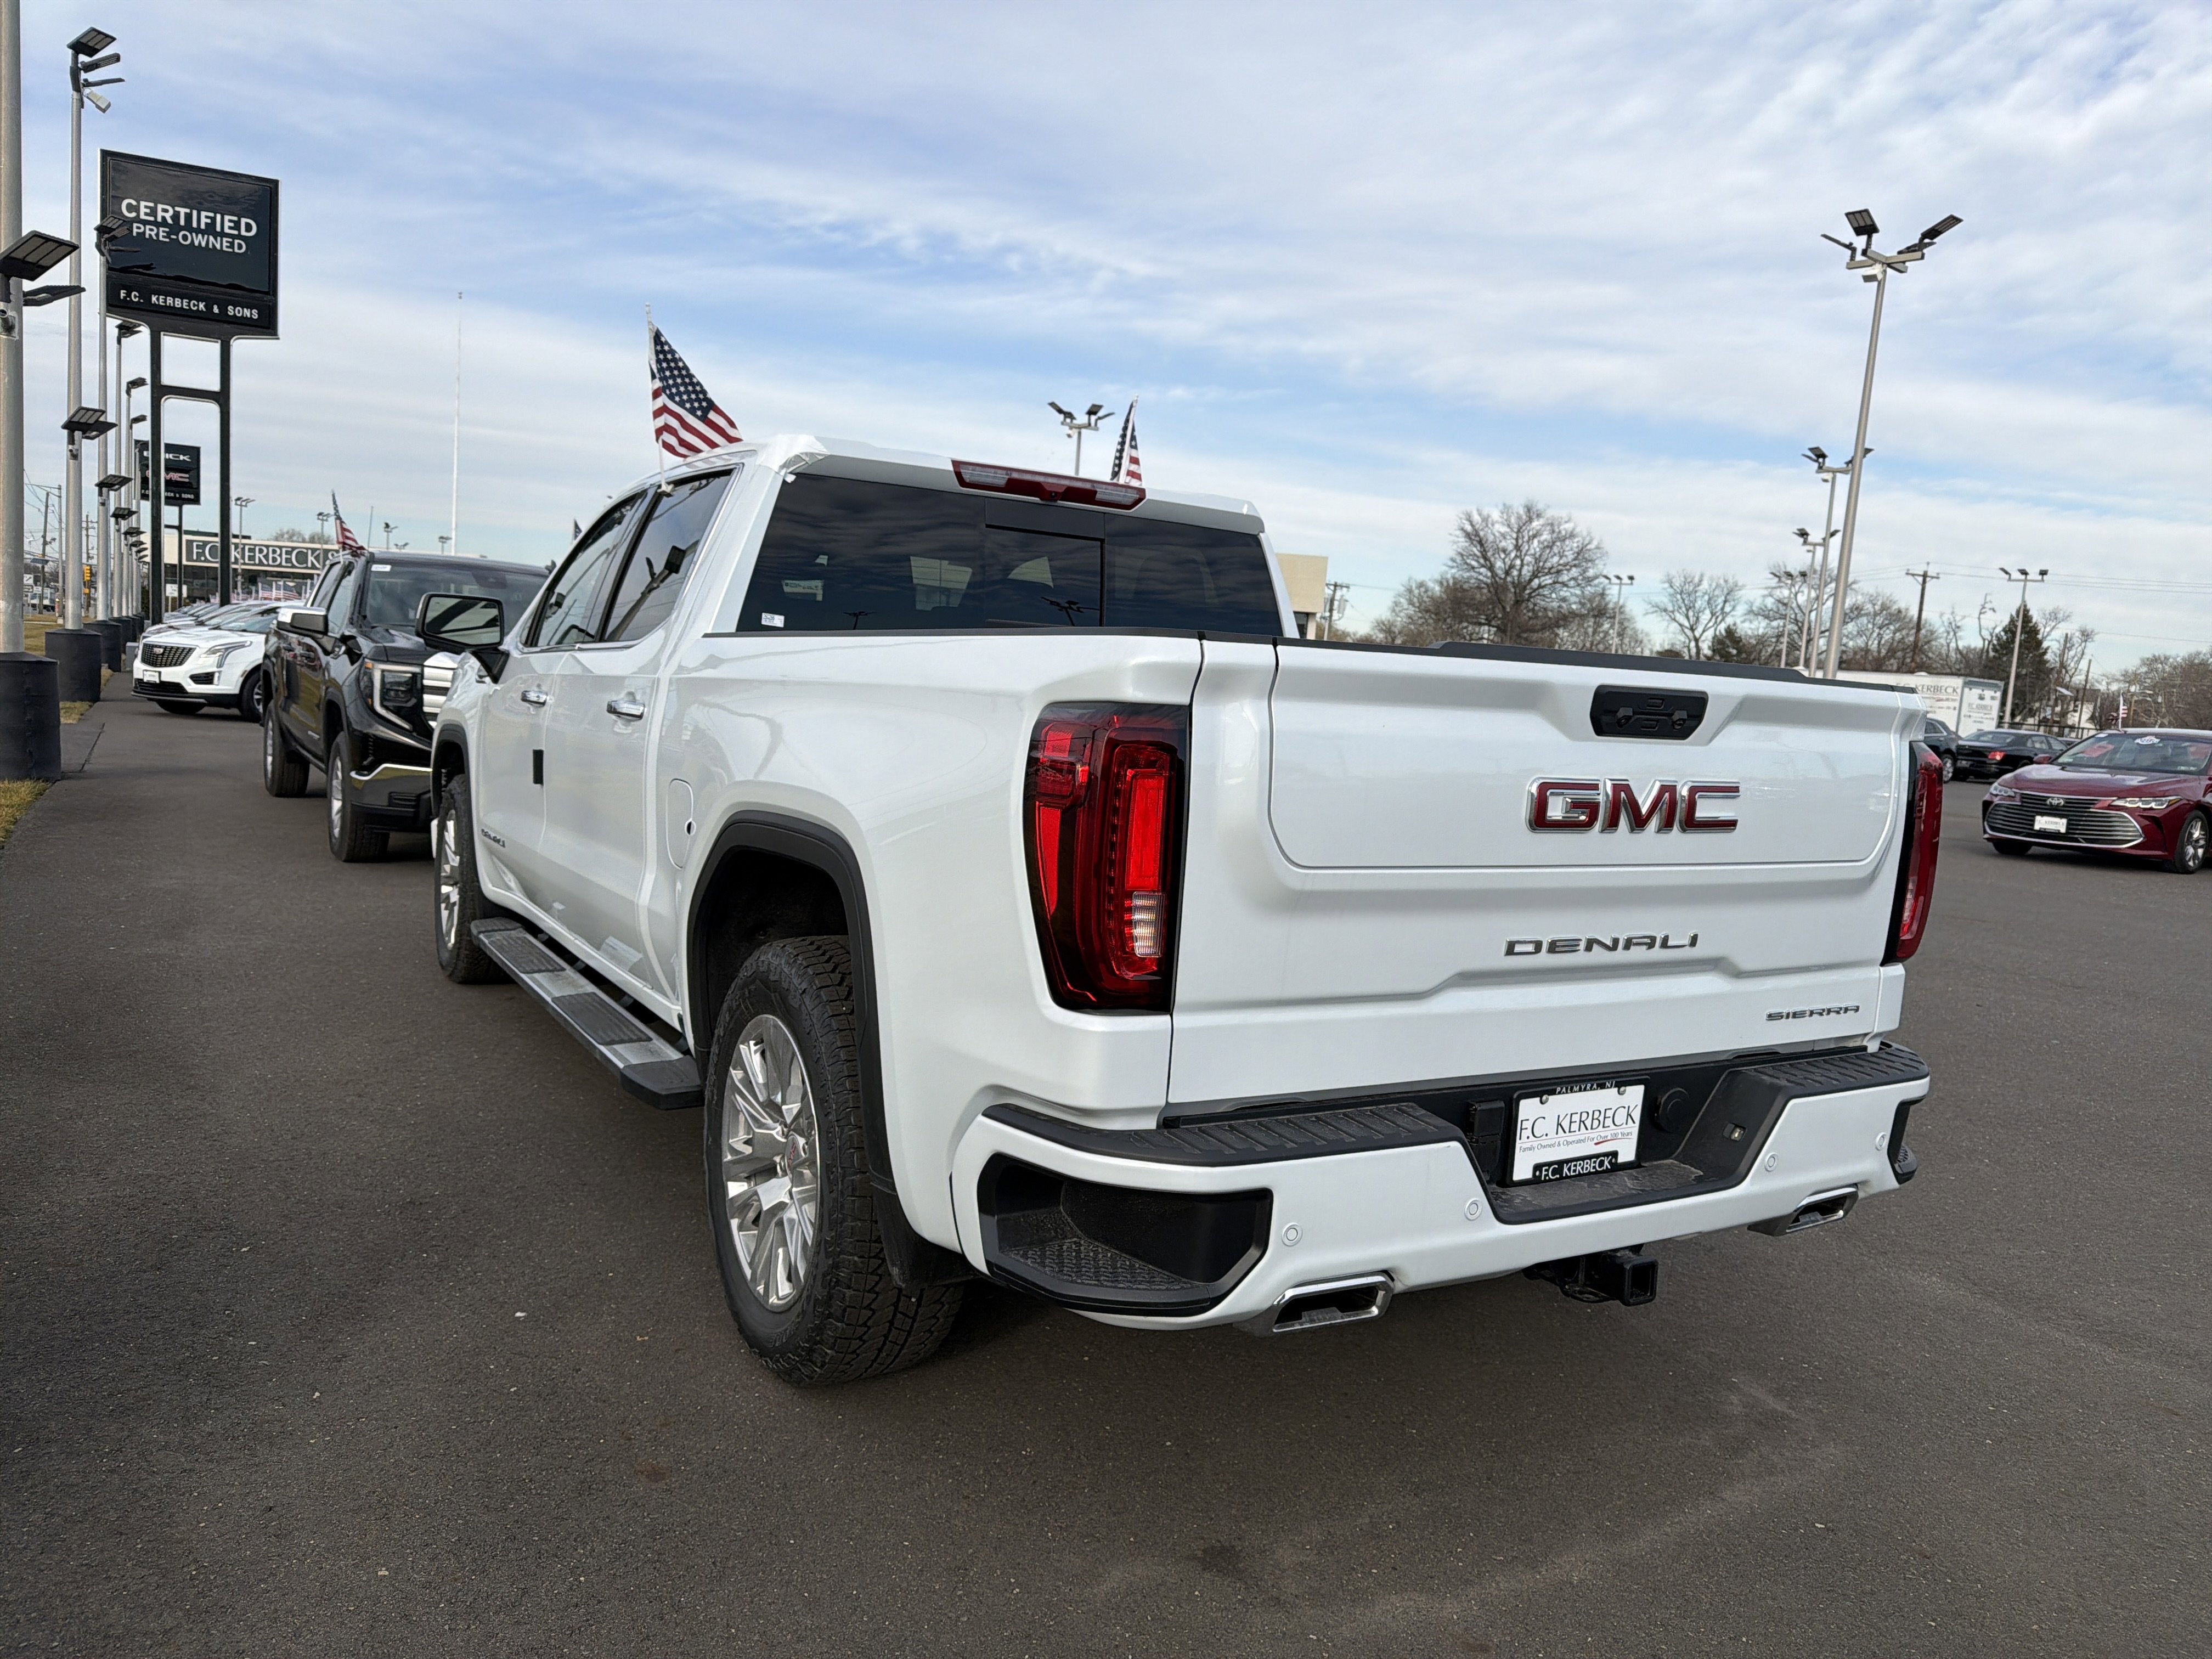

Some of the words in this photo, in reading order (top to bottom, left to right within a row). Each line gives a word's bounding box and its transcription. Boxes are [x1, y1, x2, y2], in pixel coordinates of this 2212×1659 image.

[121, 198, 257, 236] CERTIFIED
[132, 223, 246, 253] PRE-OWNED
[120, 290, 144, 302] F.C.
[151, 294, 206, 312] KERBECK
[213, 304, 219, 314] &
[227, 306, 258, 319] SONS
[143, 451, 191, 461] BICK
[193, 541, 219, 561] F.C
[231, 544, 321, 568] KERBECK
[1525, 777, 1741, 833] GMC
[1504, 932, 1699, 956] DENALI
[1765, 1003, 1860, 1021] SIERRA
[1556, 1083, 1600, 1094] PALMYRA,
[1605, 1080, 1616, 1089] NJ
[1519, 1116, 1548, 1141] F.C.
[1555, 1104, 1638, 1136] KERBECK
[1519, 1144, 1536, 1153] Family
[1537, 1141, 1556, 1150] Owned
[1562, 1137, 1586, 1148] Operated
[1541, 1165, 1560, 1181] F.C.
[1562, 1156, 1612, 1177] KERBECK
